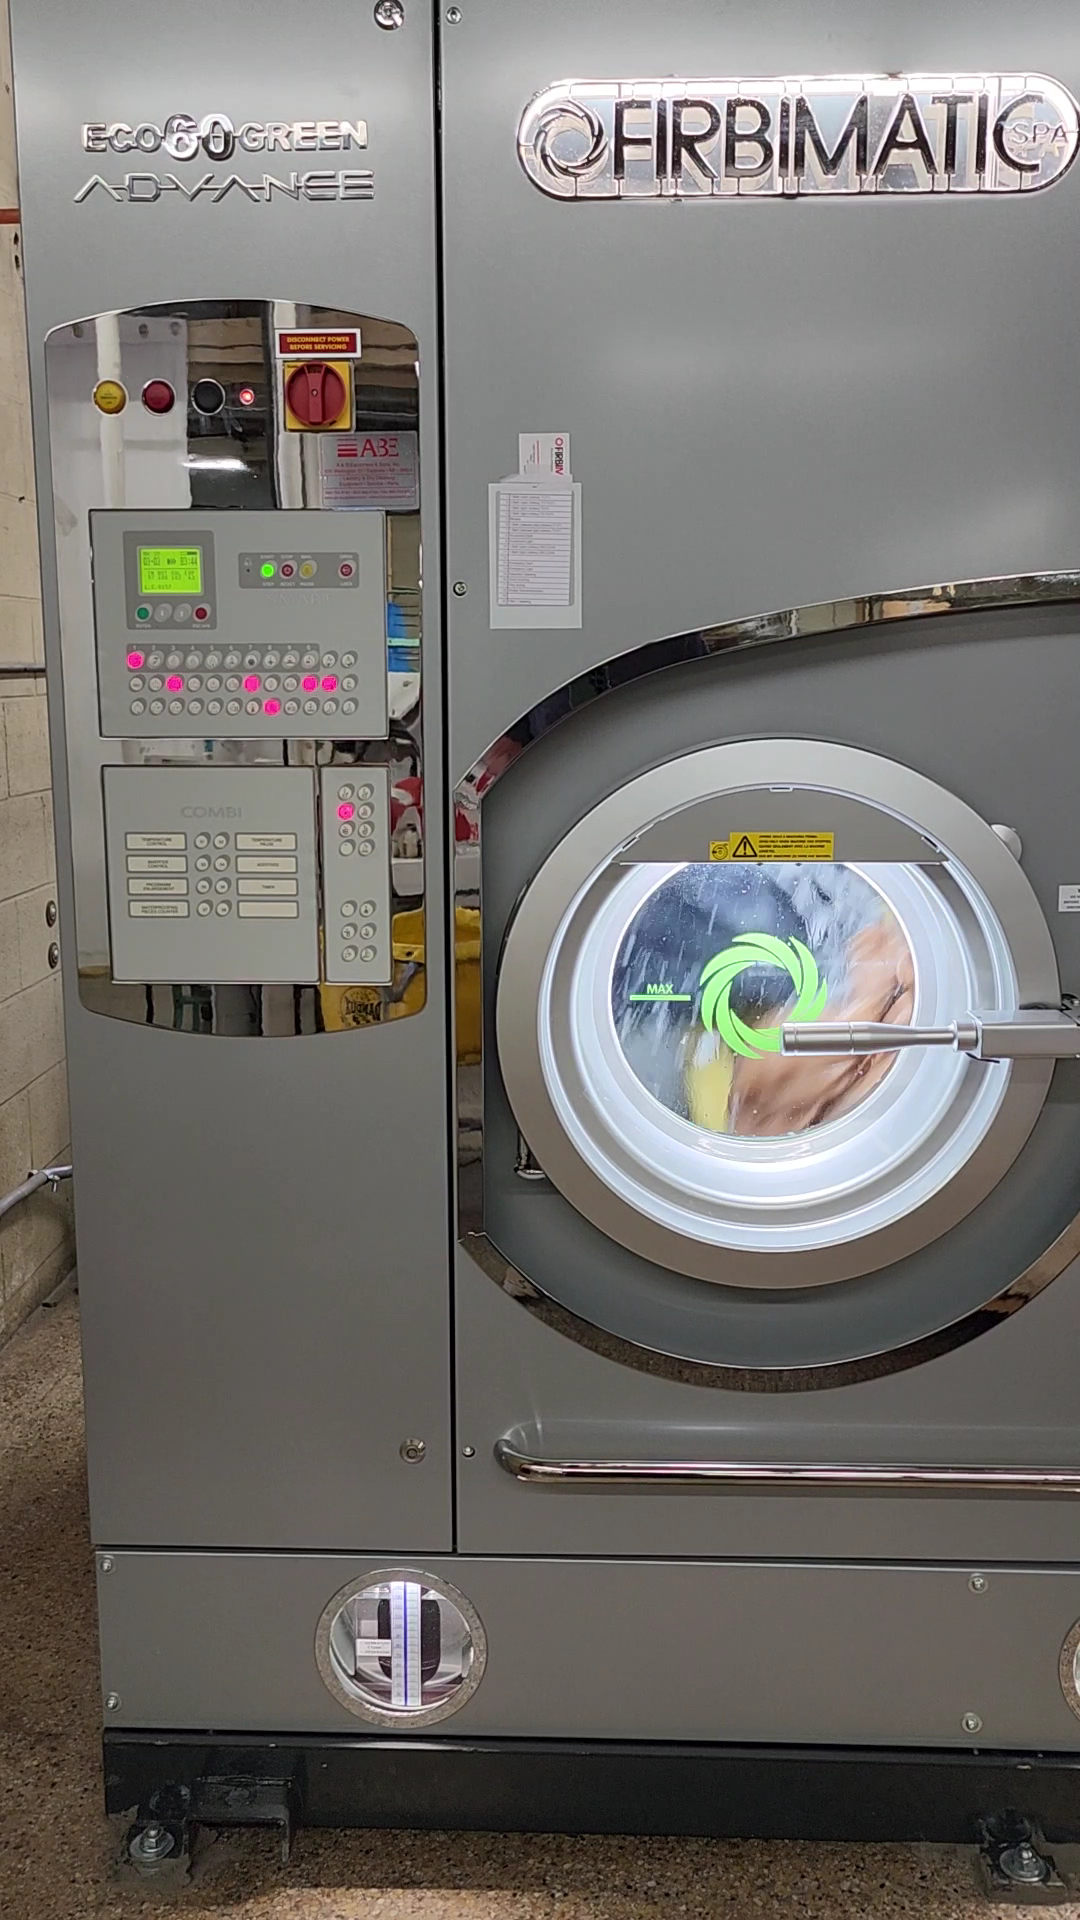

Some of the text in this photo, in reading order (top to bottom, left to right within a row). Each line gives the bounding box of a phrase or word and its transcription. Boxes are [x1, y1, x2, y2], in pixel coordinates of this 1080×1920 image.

[613, 93, 1043, 181] FIRBIMATIC
[1010, 122, 1069, 144] SPA
[73, 170, 375, 202] ADVANCE
[359, 437, 399, 458] ABE
[180, 805, 243, 818] COMBI
[646, 983, 674, 994] MAX
